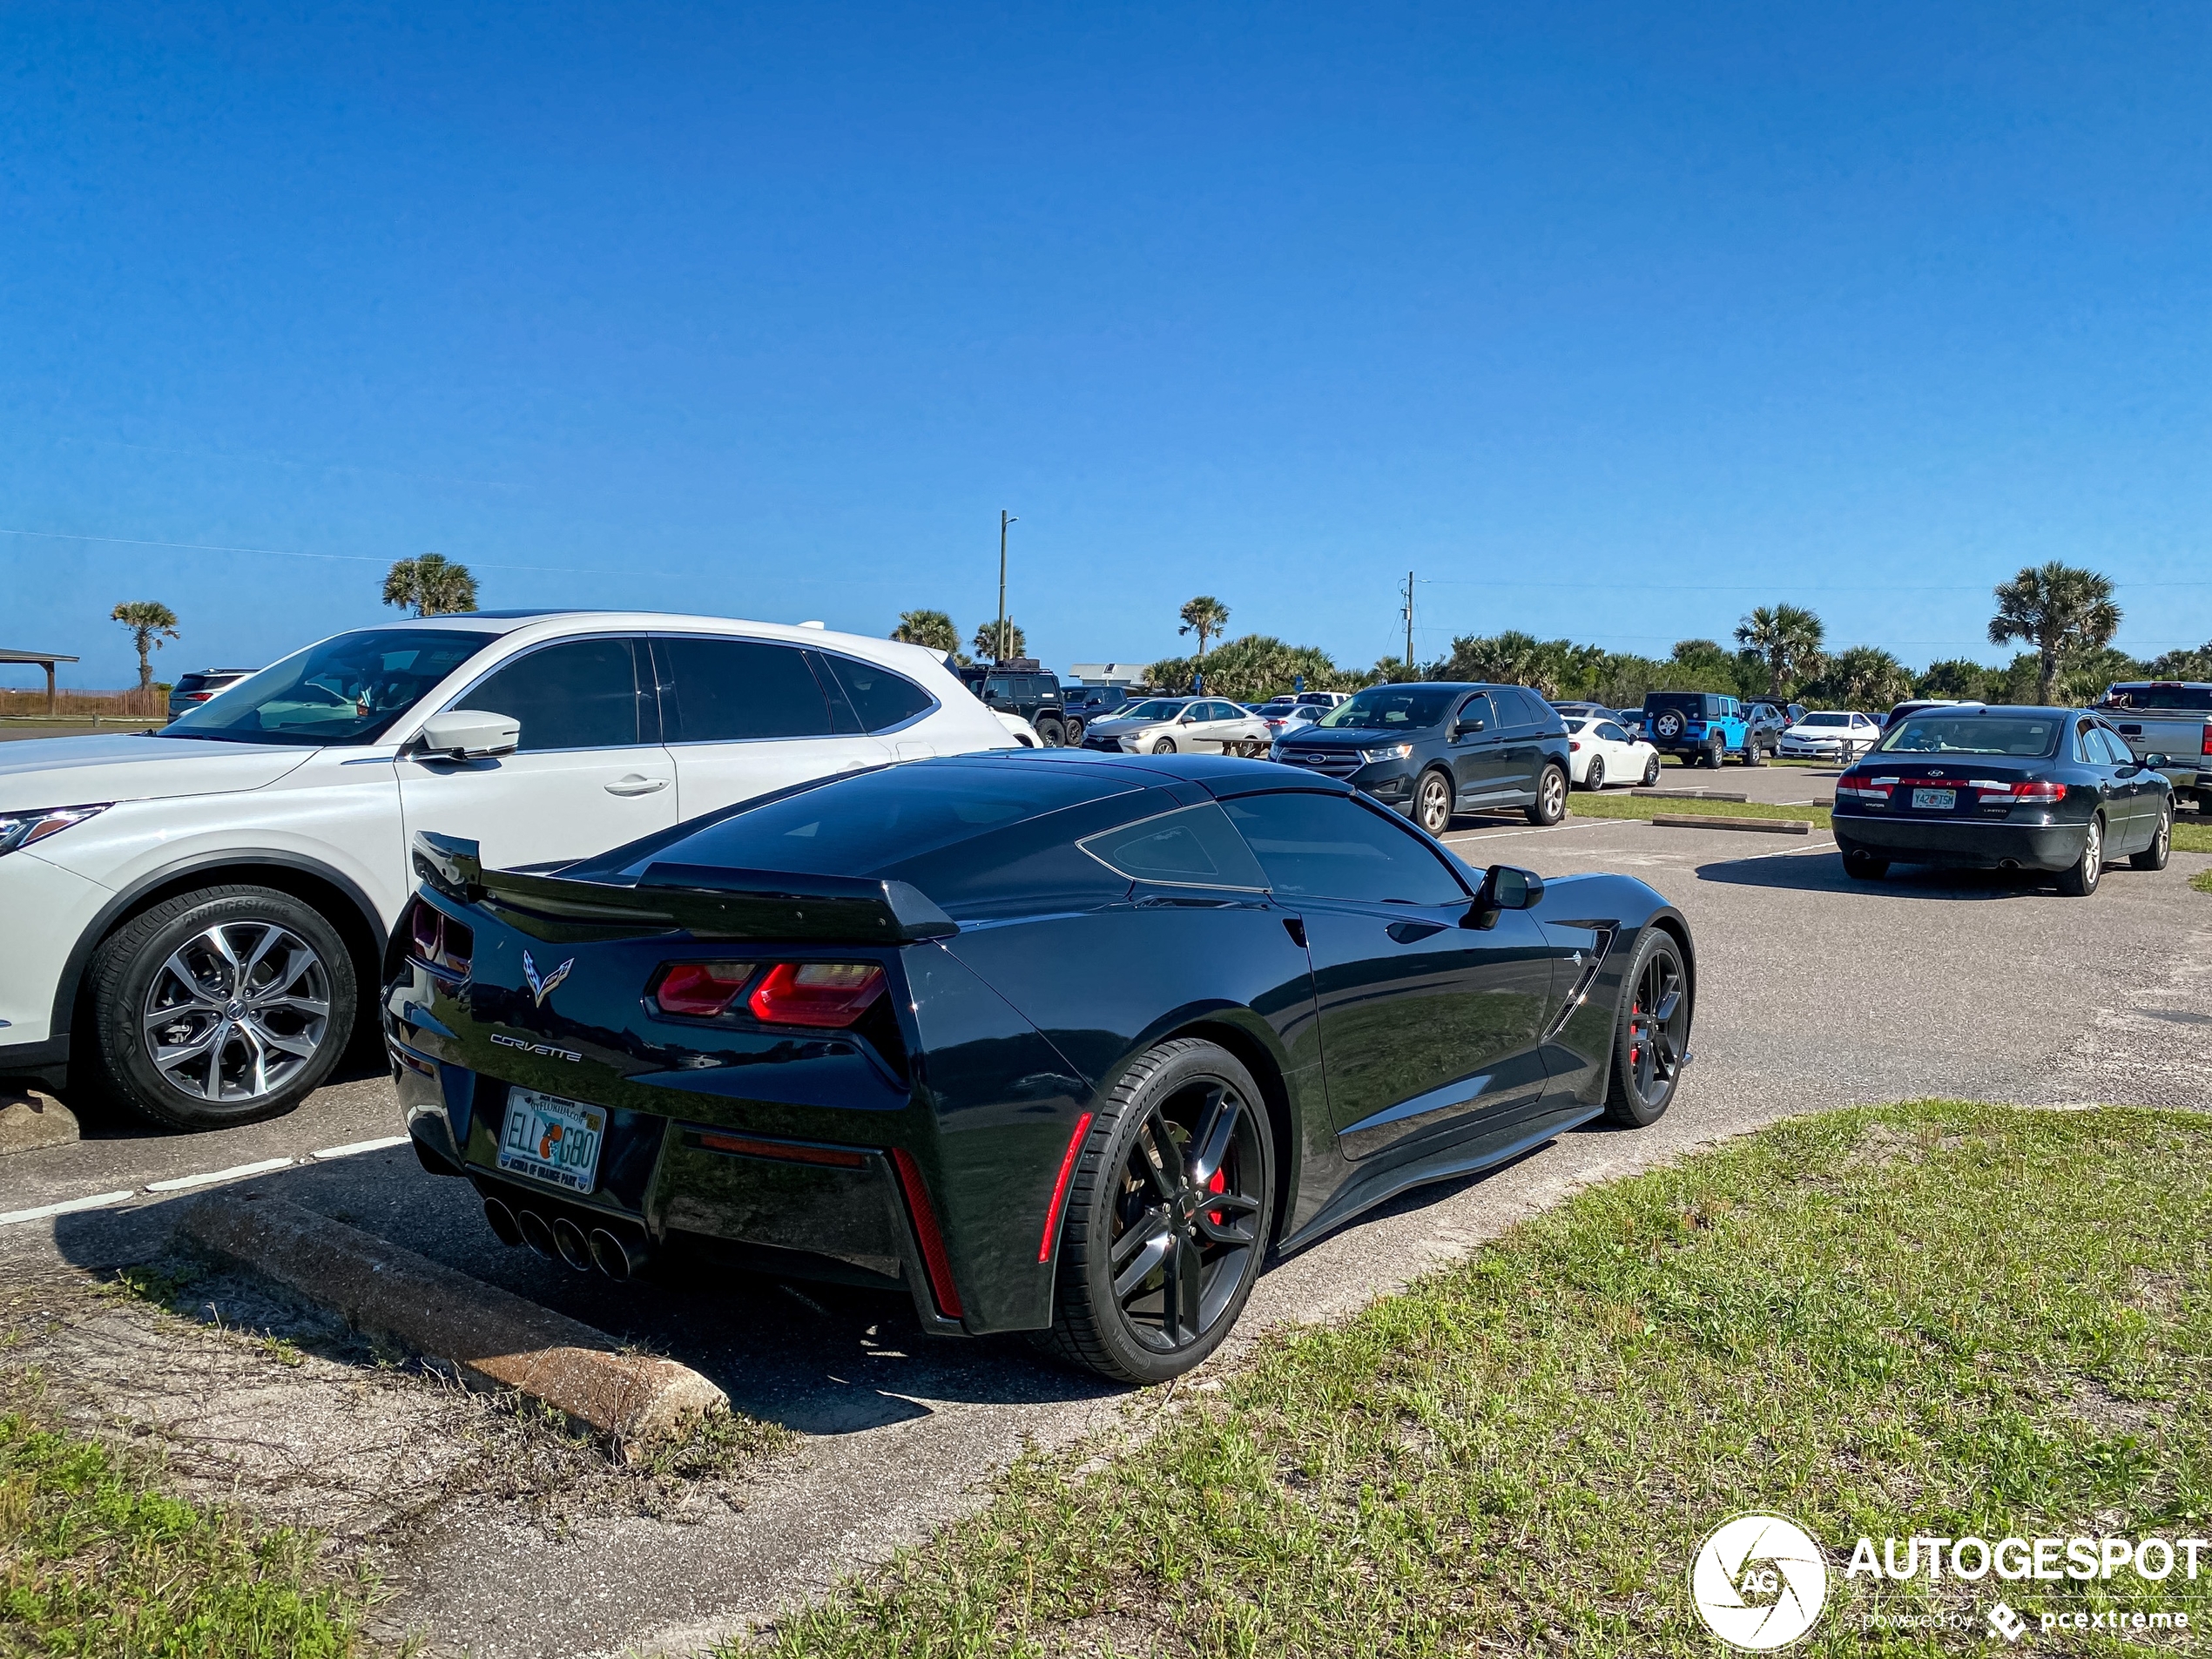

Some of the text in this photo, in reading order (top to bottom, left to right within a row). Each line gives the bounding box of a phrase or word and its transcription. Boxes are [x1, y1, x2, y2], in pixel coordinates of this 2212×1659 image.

[183, 899, 291, 928] BRIDGESTONE
[490, 1033, 583, 1062] CORVETTE
[507, 1111, 537, 1155] ELL
[509, 1157, 528, 1173] ACURA
[529, 1163, 537, 1176] OF
[537, 1166, 561, 1182] ORANGE
[561, 1173, 577, 1187] PARK
